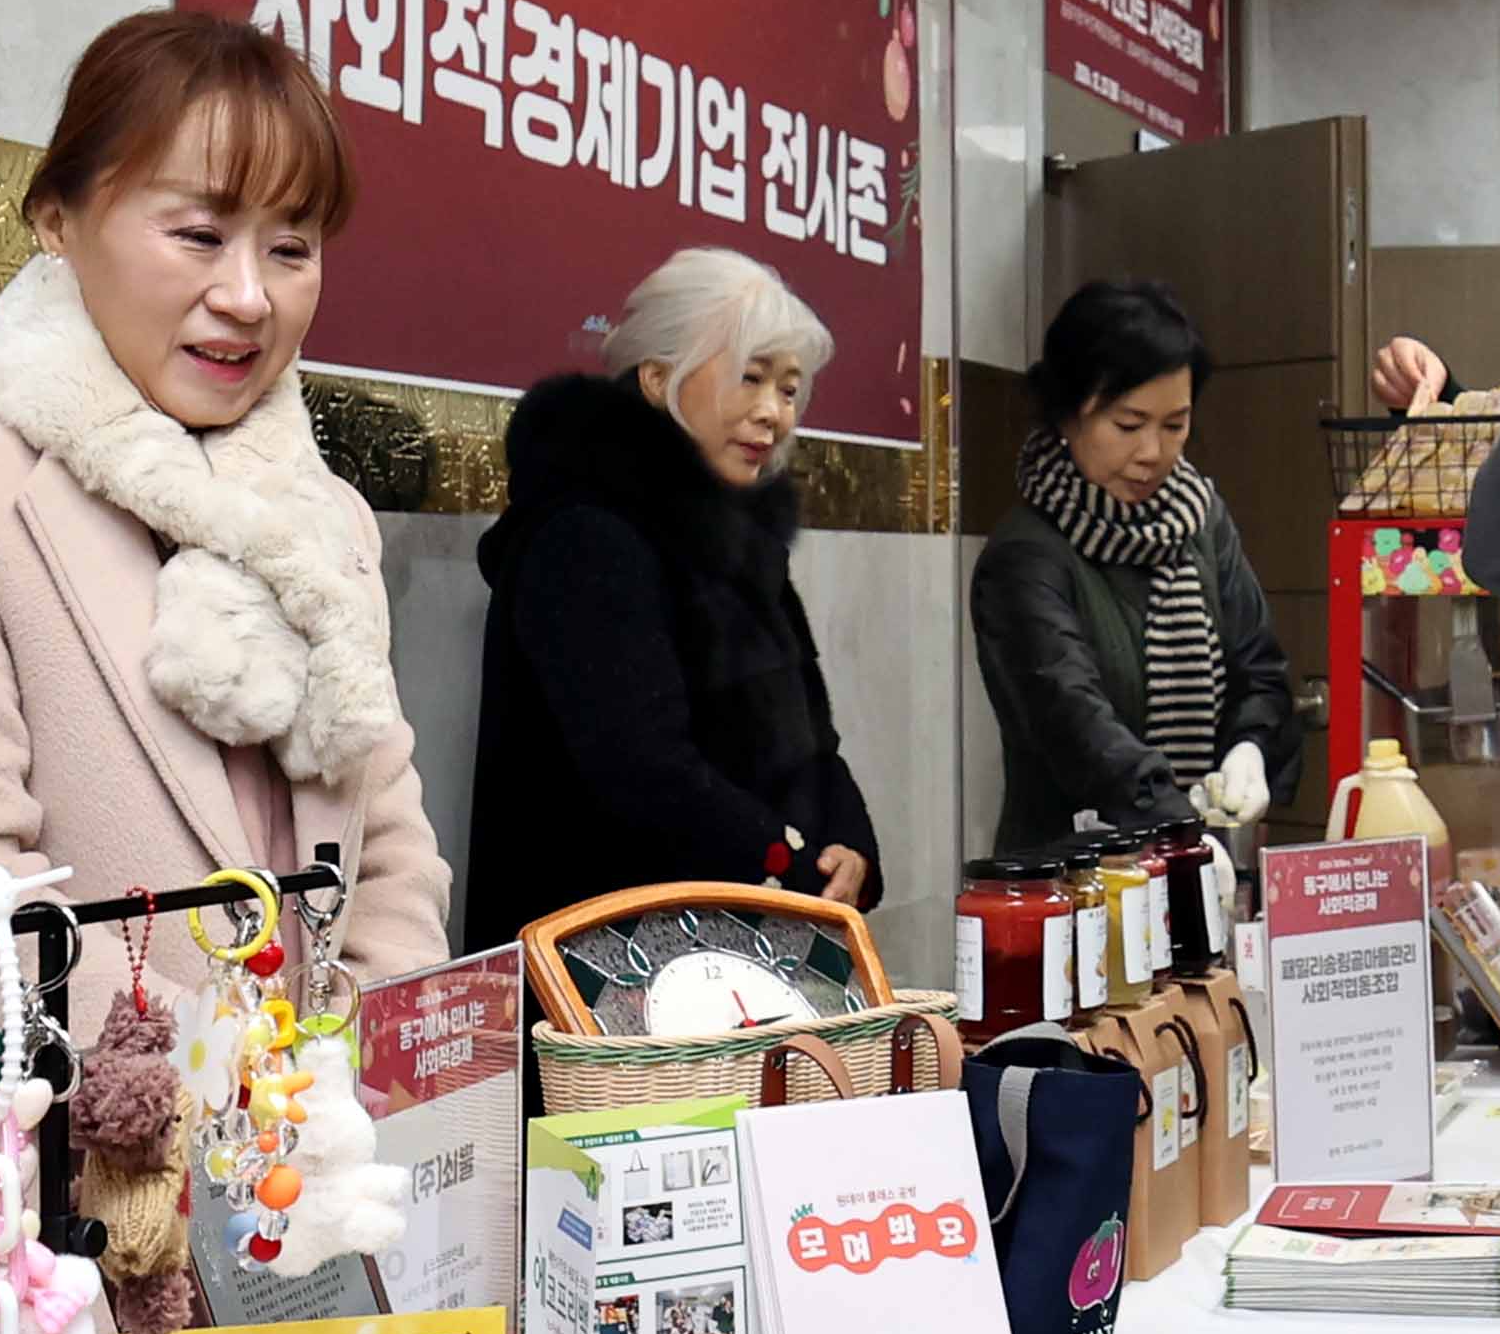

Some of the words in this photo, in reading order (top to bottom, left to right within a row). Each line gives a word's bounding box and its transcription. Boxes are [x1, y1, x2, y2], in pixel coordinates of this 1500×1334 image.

[760, 103, 890, 267] 전시존
[704, 965, 724, 980] 12
[399, 1009, 448, 1052] 동구에서
[450, 1000, 485, 1035] 만나는
